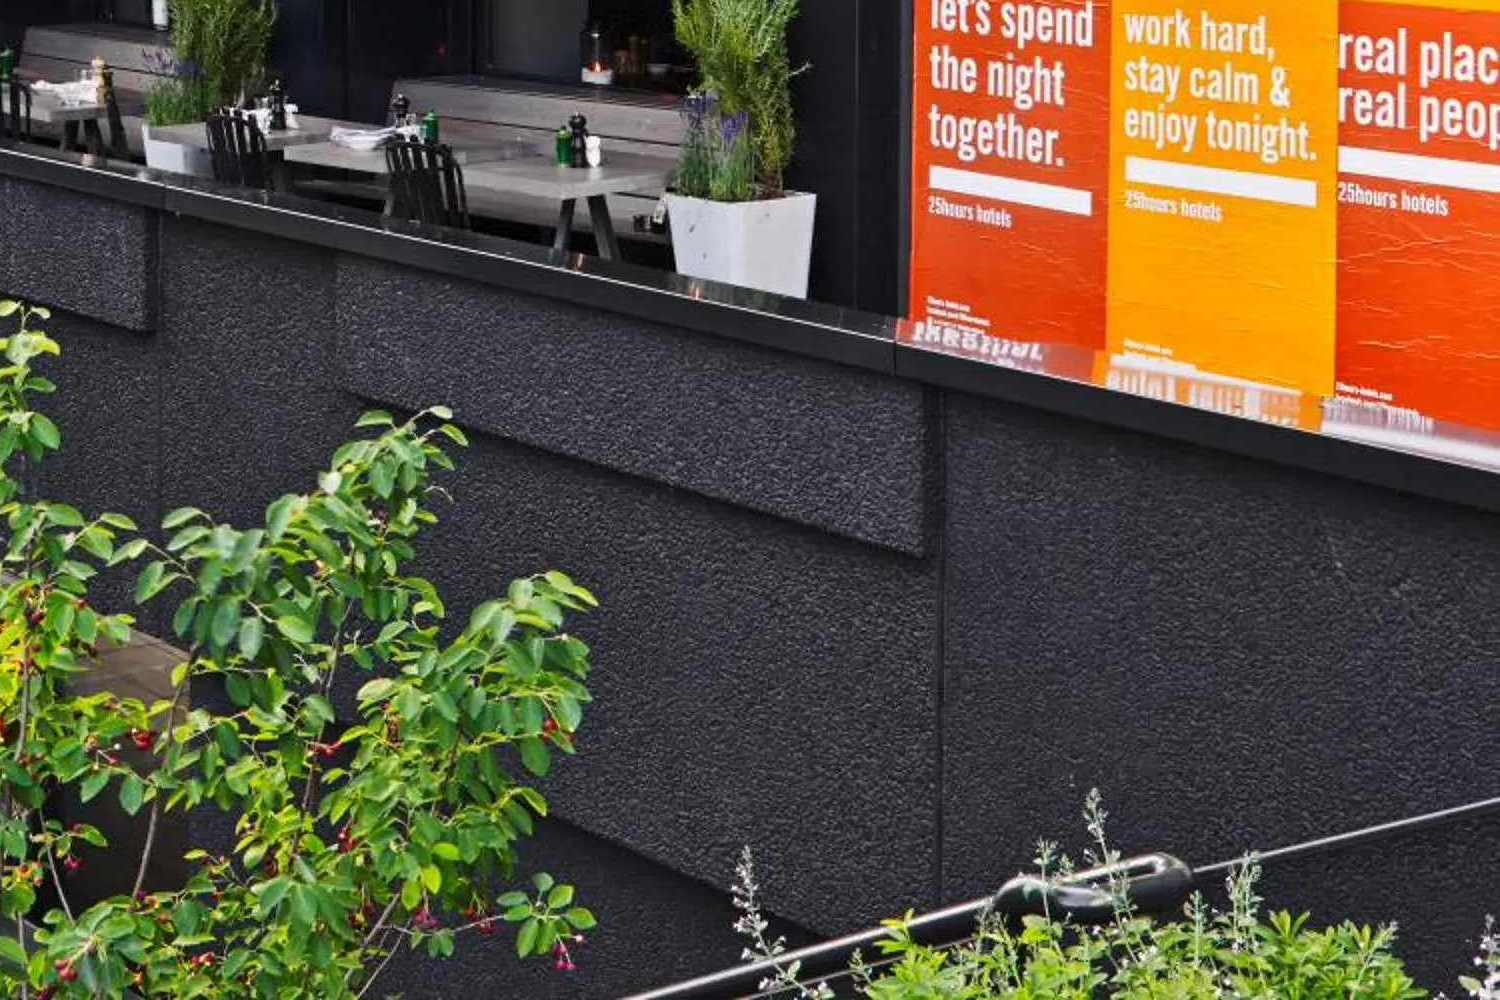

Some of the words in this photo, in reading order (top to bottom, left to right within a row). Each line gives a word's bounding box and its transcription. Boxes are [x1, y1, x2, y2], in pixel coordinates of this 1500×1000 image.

[1002, 1, 1093, 48] spend
[1125, 10, 1190, 46] work
[1201, 11, 1274, 60] hard,
[1339, 28, 1406, 75] real
[929, 45, 978, 93] the
[988, 53, 1064, 110] night
[1125, 56, 1181, 103] stay
[1190, 62, 1259, 105] calm
[1269, 66, 1291, 107] &
[1339, 83, 1406, 129] real
[929, 103, 1064, 168] together.
[1125, 104, 1197, 152] enjoy
[1206, 115, 1316, 163] tonight.
[929, 196, 975, 221] 25hours
[976, 201, 1013, 227] hotels
[1125, 190, 1178, 214] 25hours
[1181, 200, 1221, 220] hotels
[1338, 182, 1397, 208] 25hours
[1401, 191, 1448, 216] hotels
